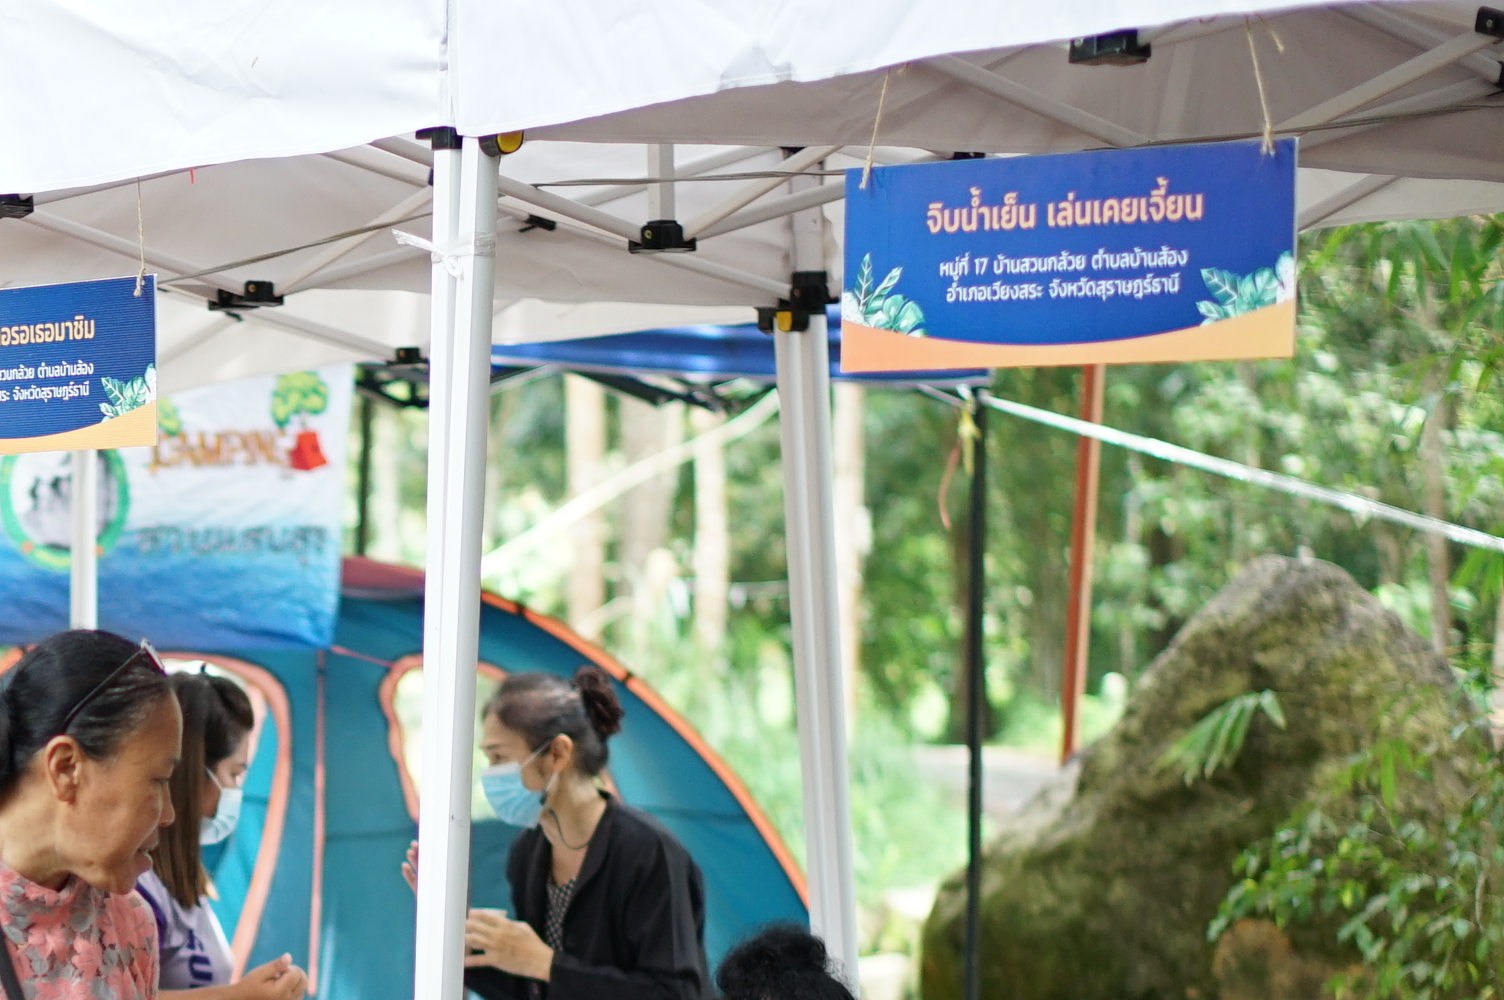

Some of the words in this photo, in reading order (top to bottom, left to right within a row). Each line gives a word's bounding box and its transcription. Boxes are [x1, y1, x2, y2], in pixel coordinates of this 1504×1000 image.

[926, 186, 1036, 235] จิบน้ำเย็น
[1047, 176, 1204, 228] เล่นเคยเจี้ยน
[939, 251, 969, 281] หมู่ที่
[974, 257, 988, 275] 17
[993, 250, 1086, 275] บ้านสวนกล้วย
[1091, 245, 1189, 270] ตำบลบ้านส้อง
[946, 279, 1043, 302] อำเภอเวียงสระ
[1049, 271, 1180, 302] จังหวัดสุราษฎร์ธานี
[37, 359, 94, 379] ตำบลบ้านส้อง
[12, 380, 90, 402] จังหวัดสุราษฎร์ธานี
